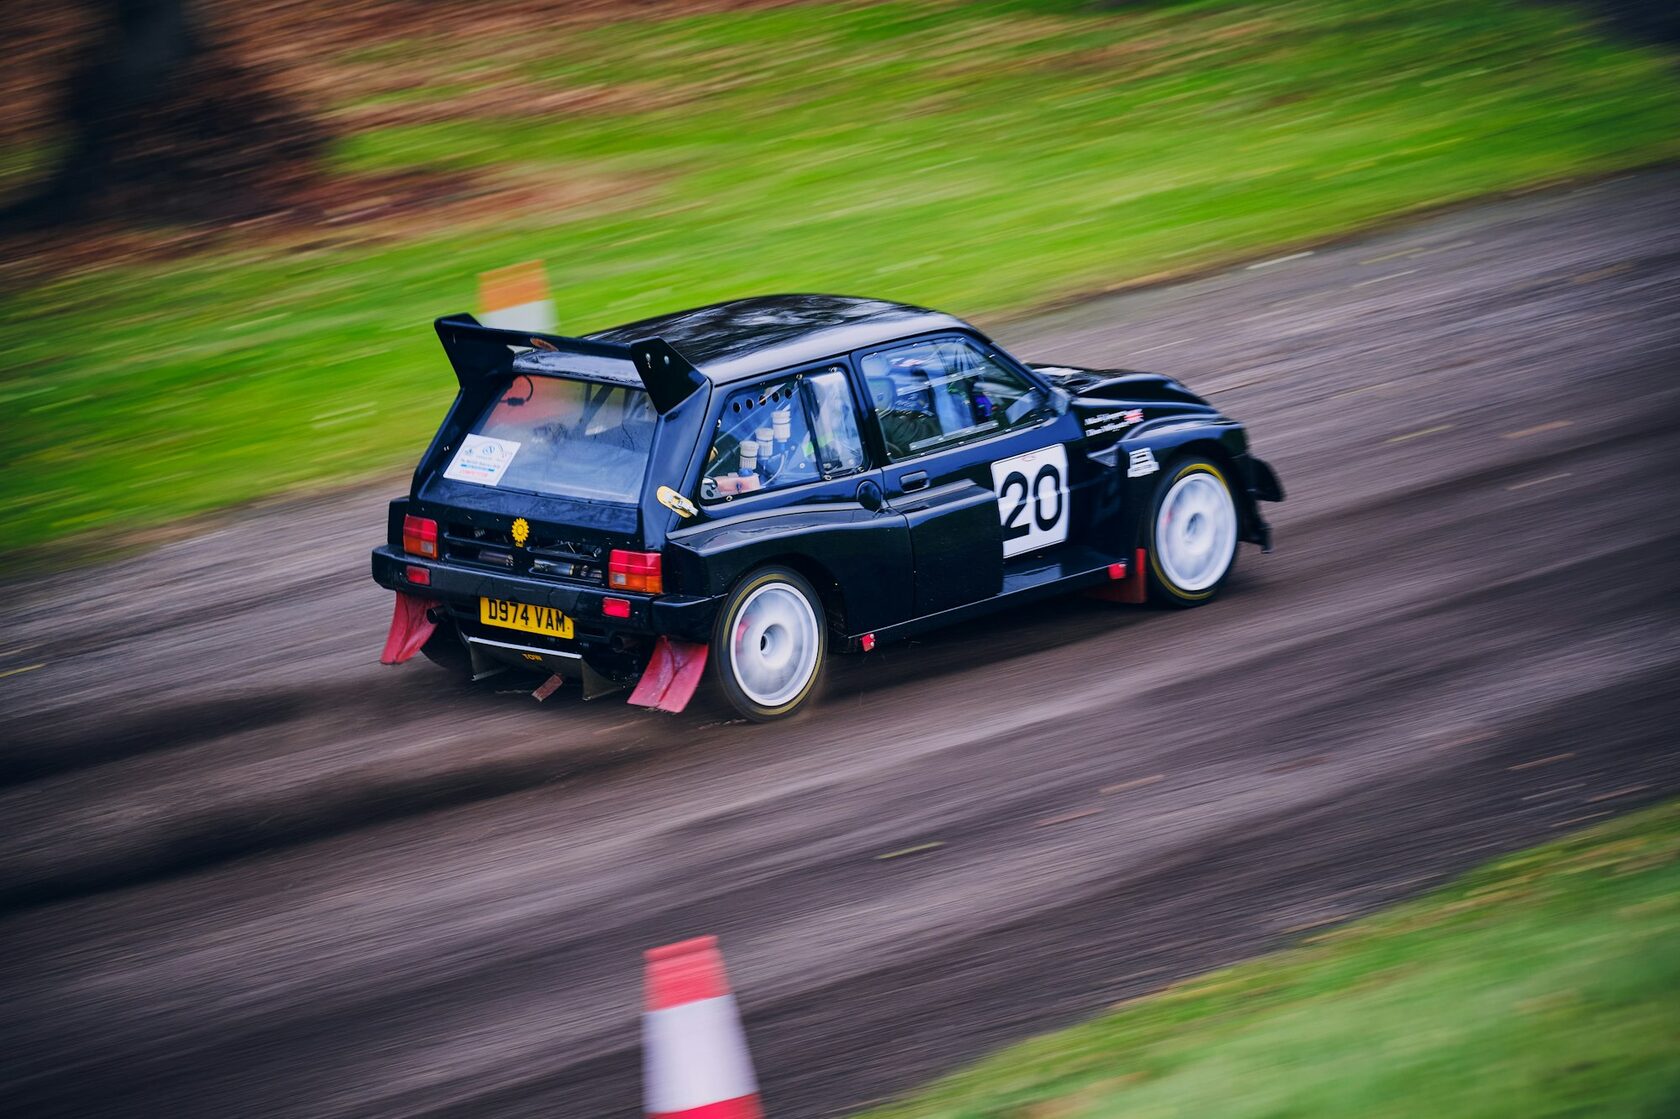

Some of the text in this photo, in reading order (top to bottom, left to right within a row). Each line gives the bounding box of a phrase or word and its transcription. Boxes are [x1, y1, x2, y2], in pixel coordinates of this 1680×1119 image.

[1001, 464, 1062, 541] 20
[488, 599, 565, 632] D974 VAM
